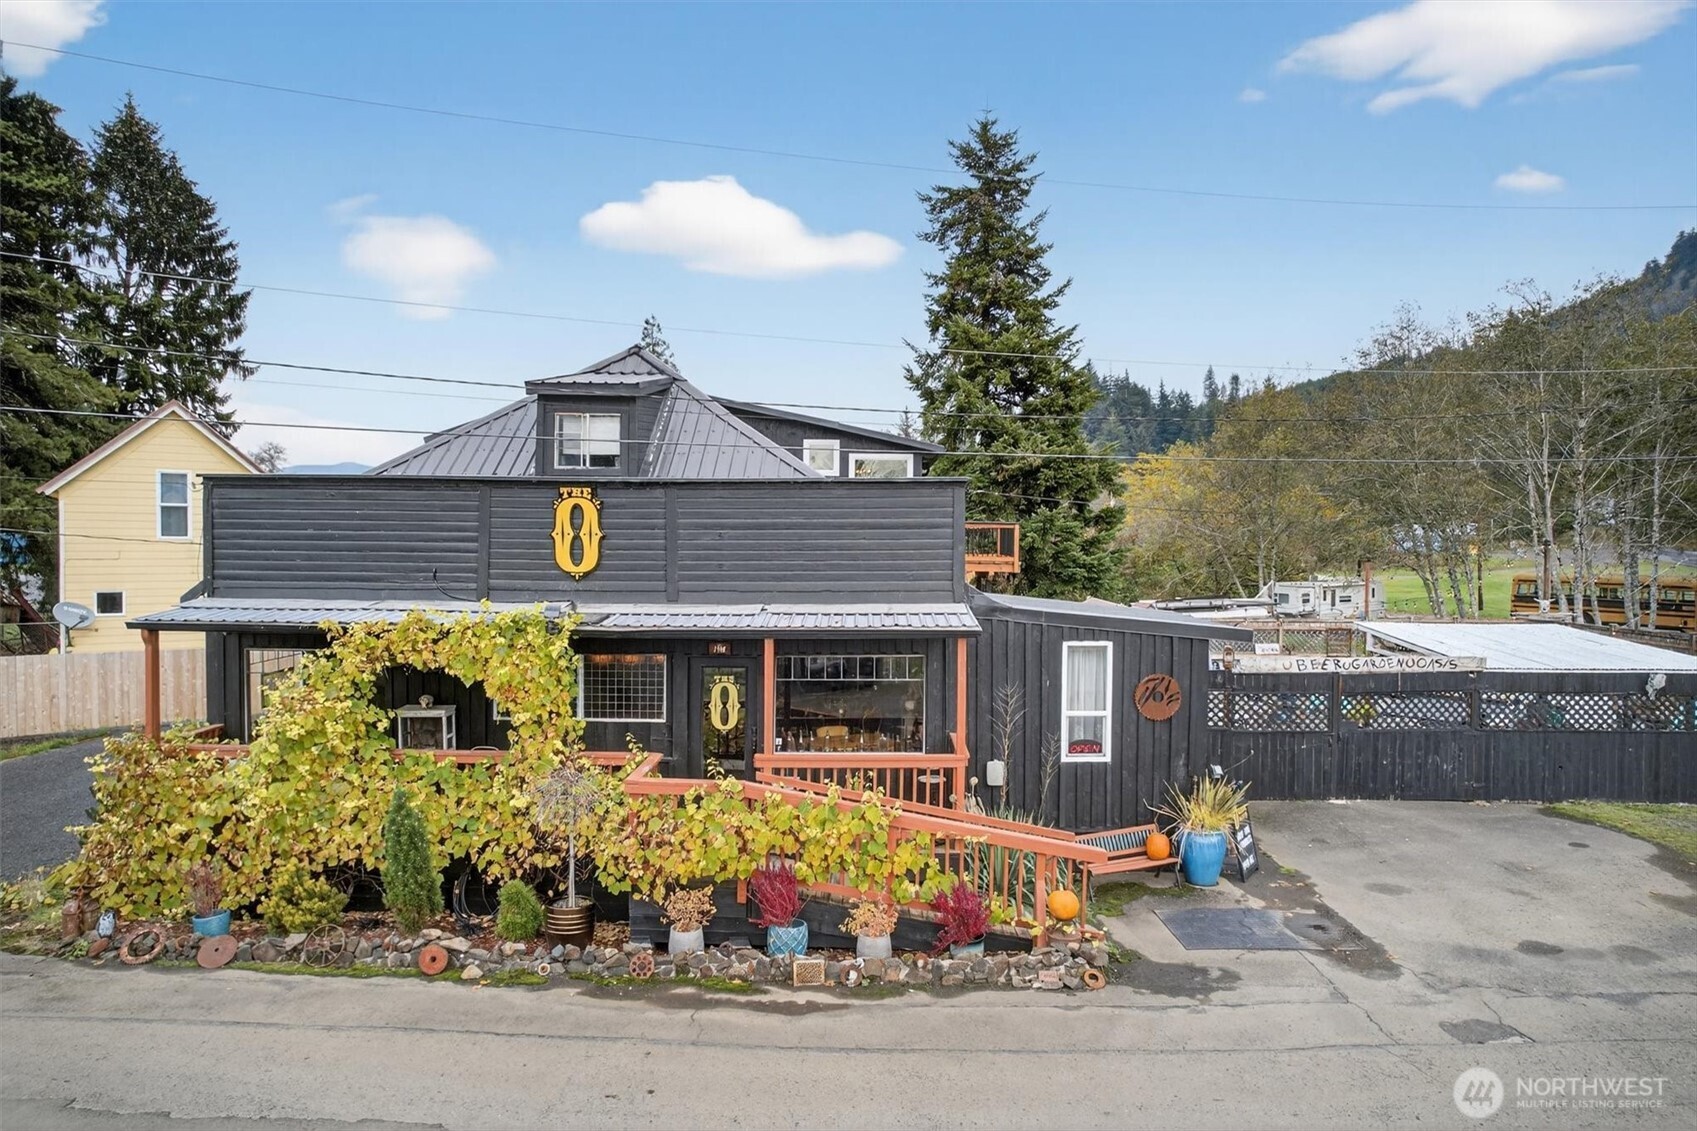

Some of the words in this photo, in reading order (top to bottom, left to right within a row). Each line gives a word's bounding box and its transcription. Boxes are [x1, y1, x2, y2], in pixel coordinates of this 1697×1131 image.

[559, 487, 592, 500] THE
[1296, 658, 1342, 671] BEER
[1070, 744, 1100, 753] OPEN
